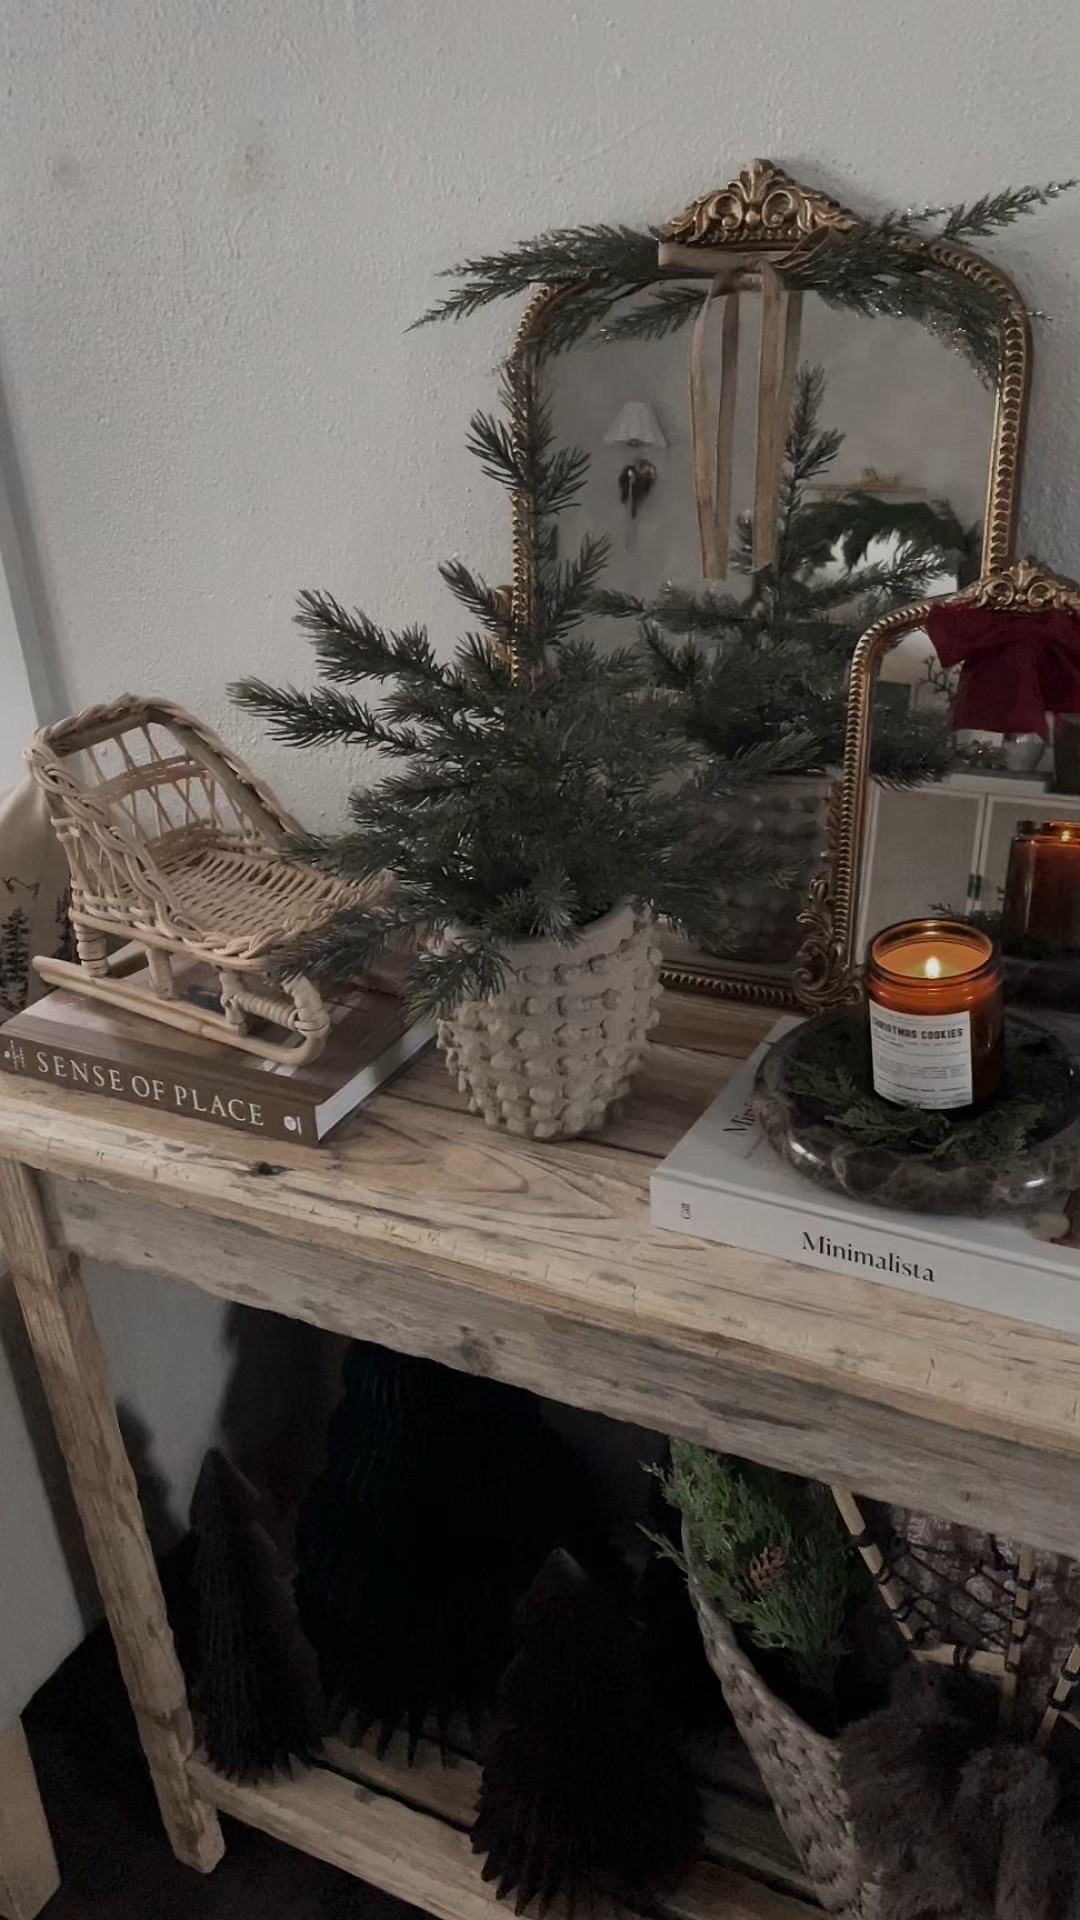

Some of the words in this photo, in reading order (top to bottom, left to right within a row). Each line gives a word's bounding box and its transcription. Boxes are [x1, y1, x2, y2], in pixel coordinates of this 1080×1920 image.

[921, 1028, 965, 1040] COOKIES
[36, 1051, 124, 1092] SENSE
[131, 1075, 165, 1102] OF
[175, 1085, 265, 1126] PLACE
[802, 1231, 936, 1283] Minimalista
